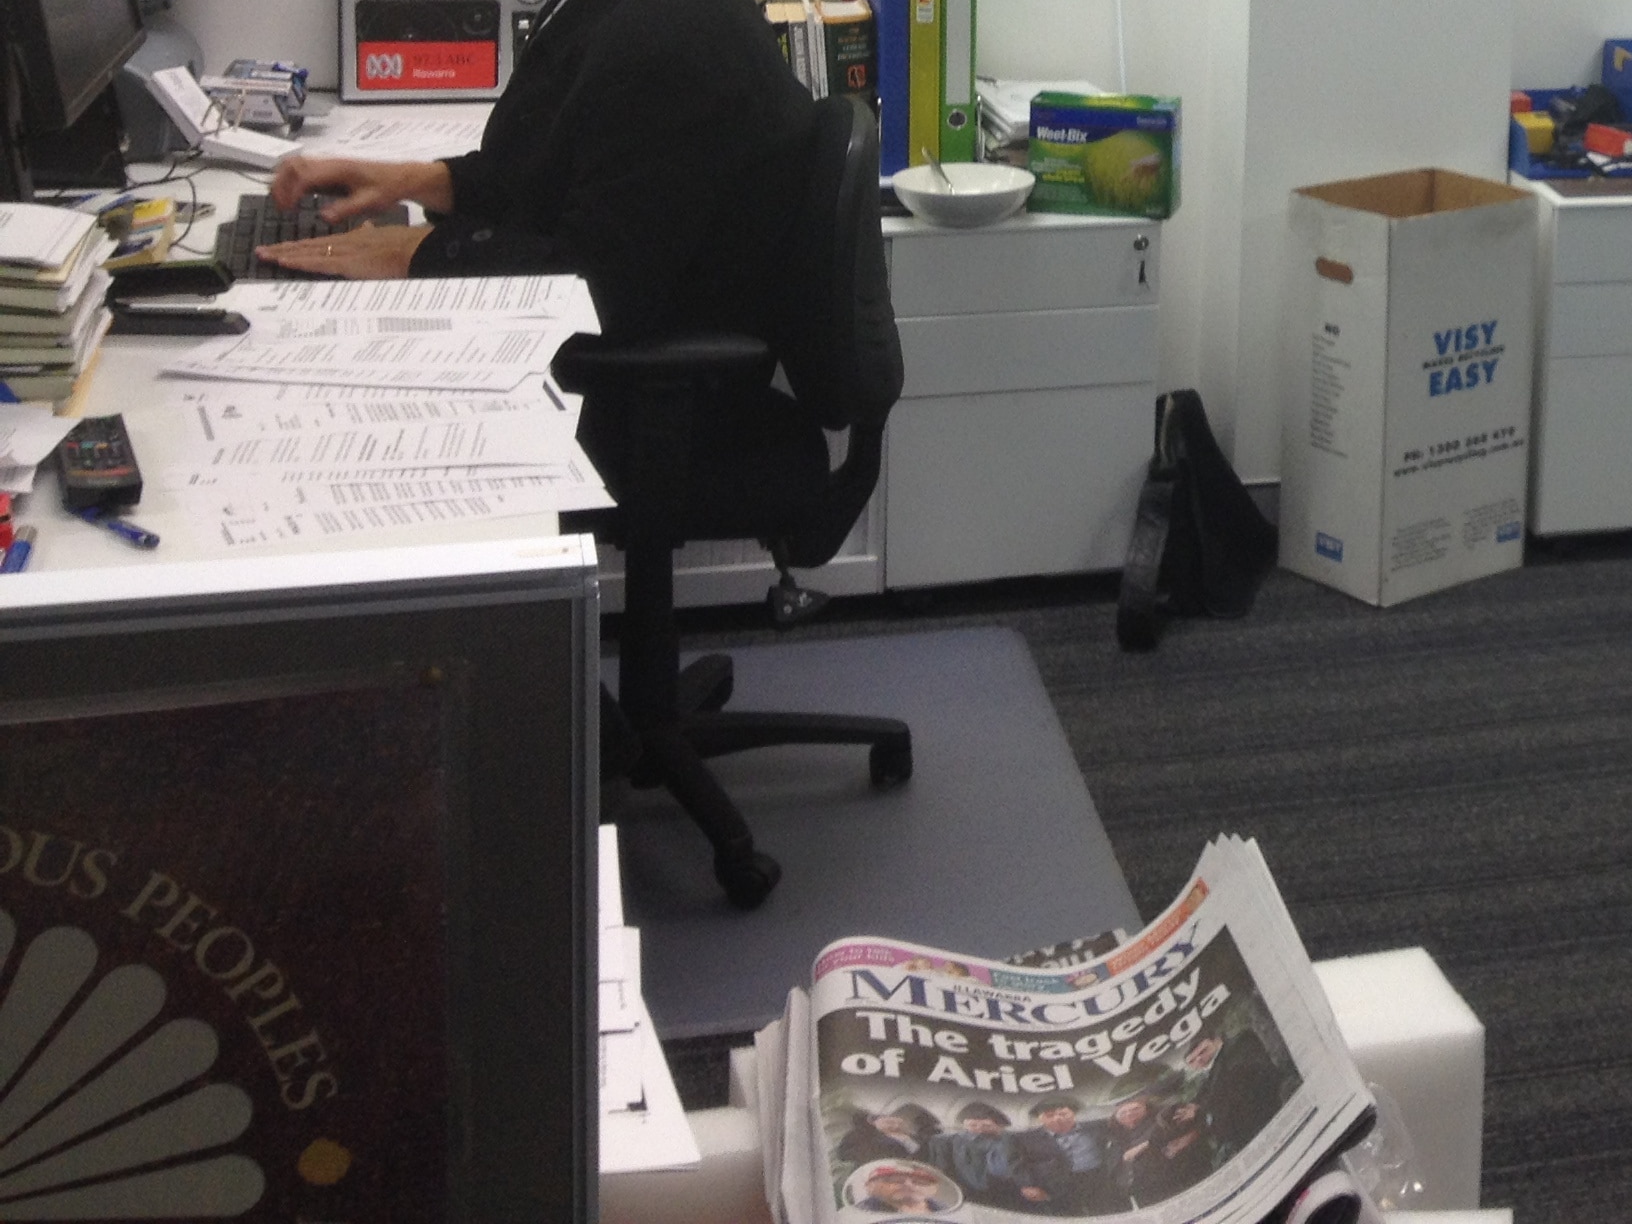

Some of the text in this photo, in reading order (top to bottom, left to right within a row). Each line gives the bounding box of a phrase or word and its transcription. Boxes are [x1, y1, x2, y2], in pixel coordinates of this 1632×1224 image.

[1429, 358, 1499, 398] EASY
[1433, 320, 1498, 356] VISY
[119, 869, 339, 1112] PEOPLES
[843, 919, 1201, 1026] MERCURY
[855, 966, 1201, 1062] The tragedy
[840, 983, 1232, 1094] of Ariel Vega
